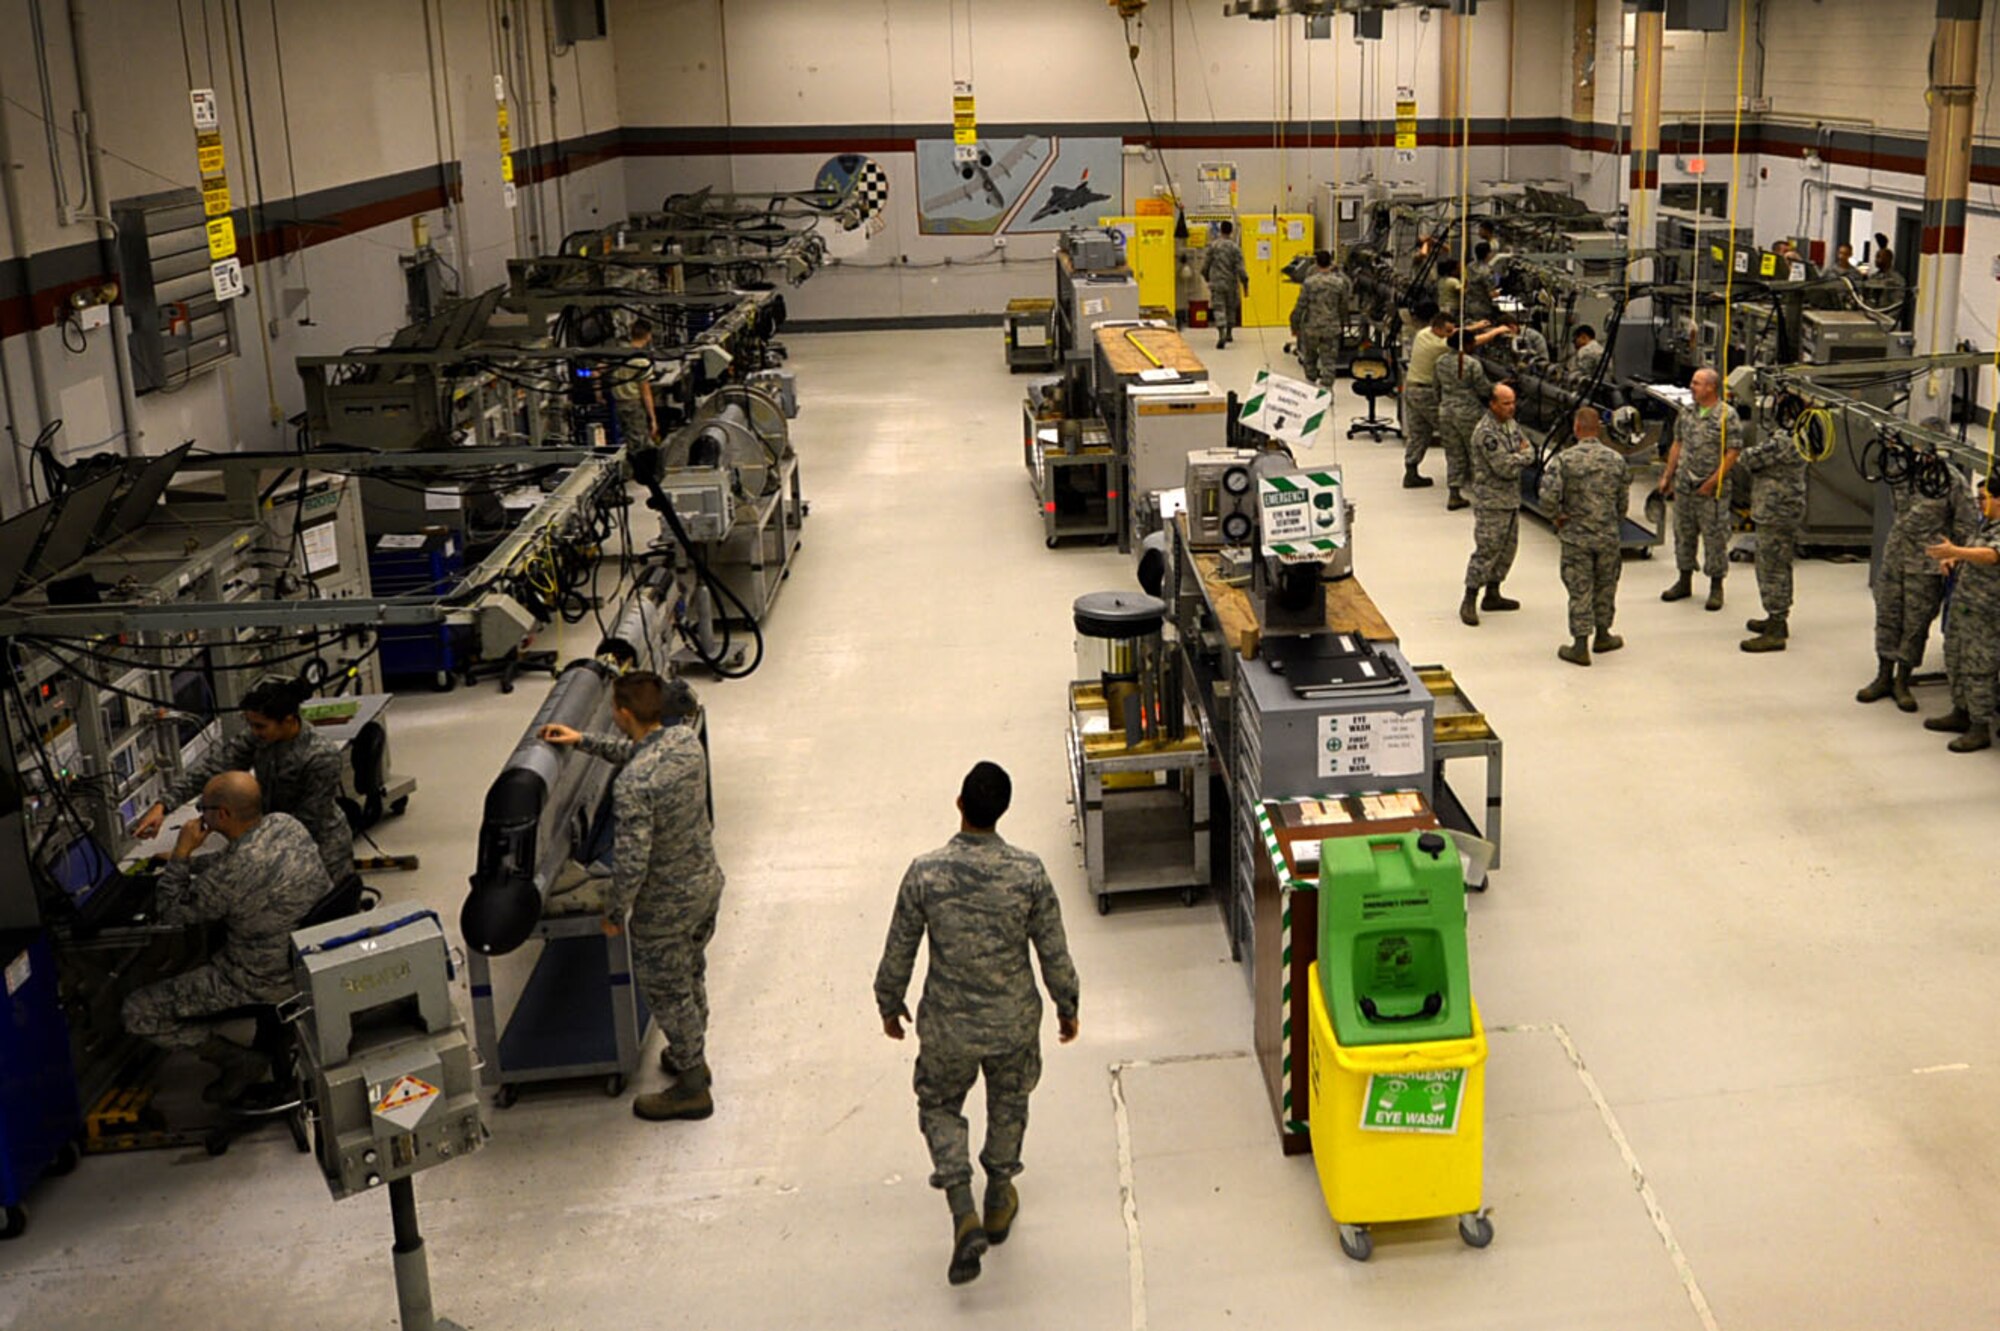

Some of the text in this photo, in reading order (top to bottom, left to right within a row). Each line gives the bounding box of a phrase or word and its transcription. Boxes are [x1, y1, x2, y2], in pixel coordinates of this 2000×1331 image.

[1277, 396, 1299, 406] SAFETY
[1265, 490, 1307, 506] EMERGENCY
[1272, 509, 1302, 519] EYE WASH
[1275, 518, 1299, 527] STATION
[1353, 716, 1366, 724] EYE
[1349, 724, 1371, 732] WASH
[1359, 742, 1370, 750] KIT
[1352, 757, 1366, 765] EYE
[1349, 764, 1370, 773] WASH
[1375, 1110, 1445, 1126] EYE WASH
